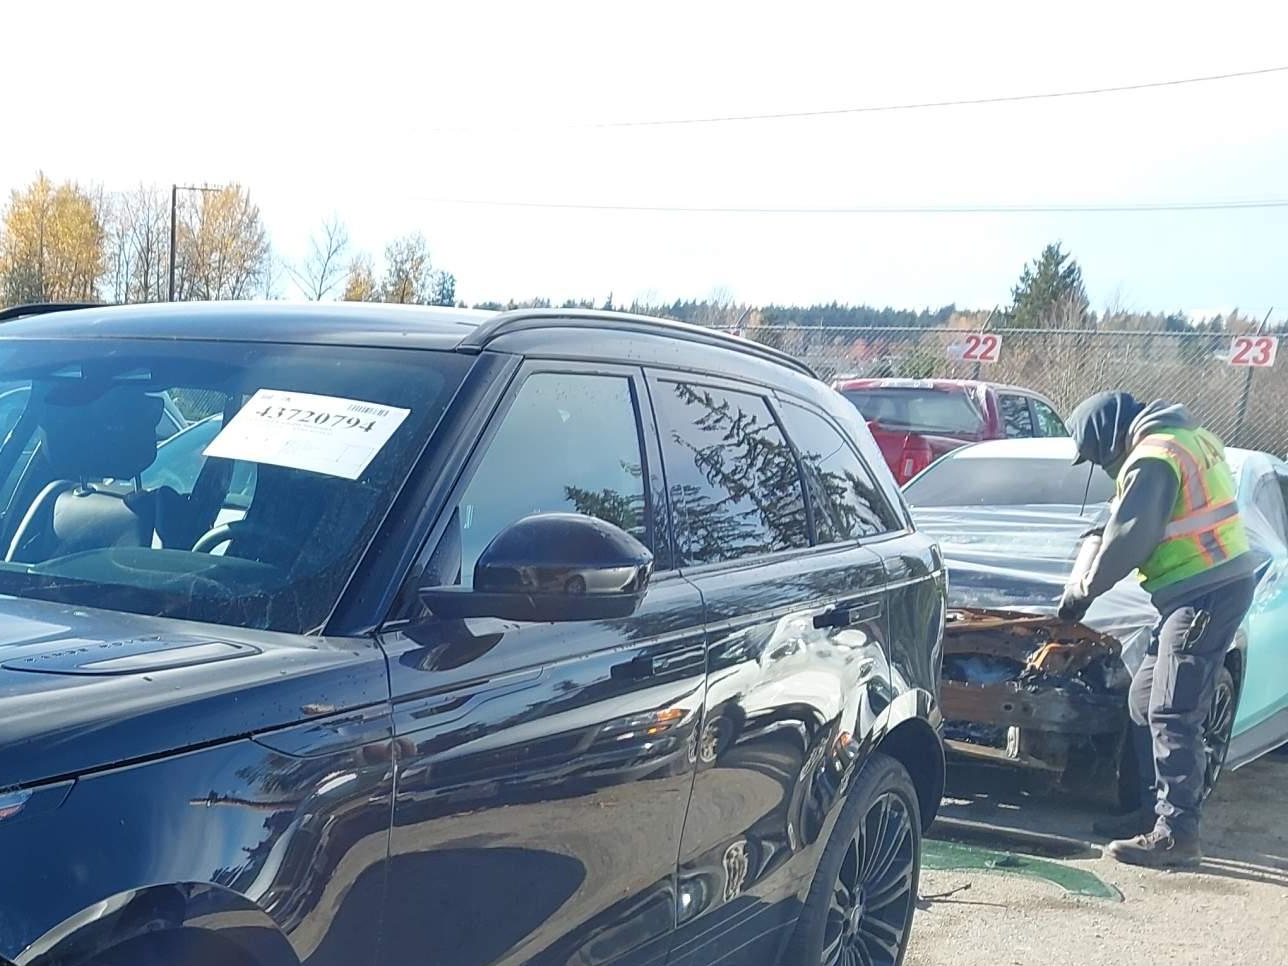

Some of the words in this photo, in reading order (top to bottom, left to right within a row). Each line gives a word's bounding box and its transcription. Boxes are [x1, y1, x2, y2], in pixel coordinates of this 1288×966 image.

[962, 335, 999, 361] 22
[1231, 338, 1273, 366] 23
[256, 405, 377, 433] 43720794
